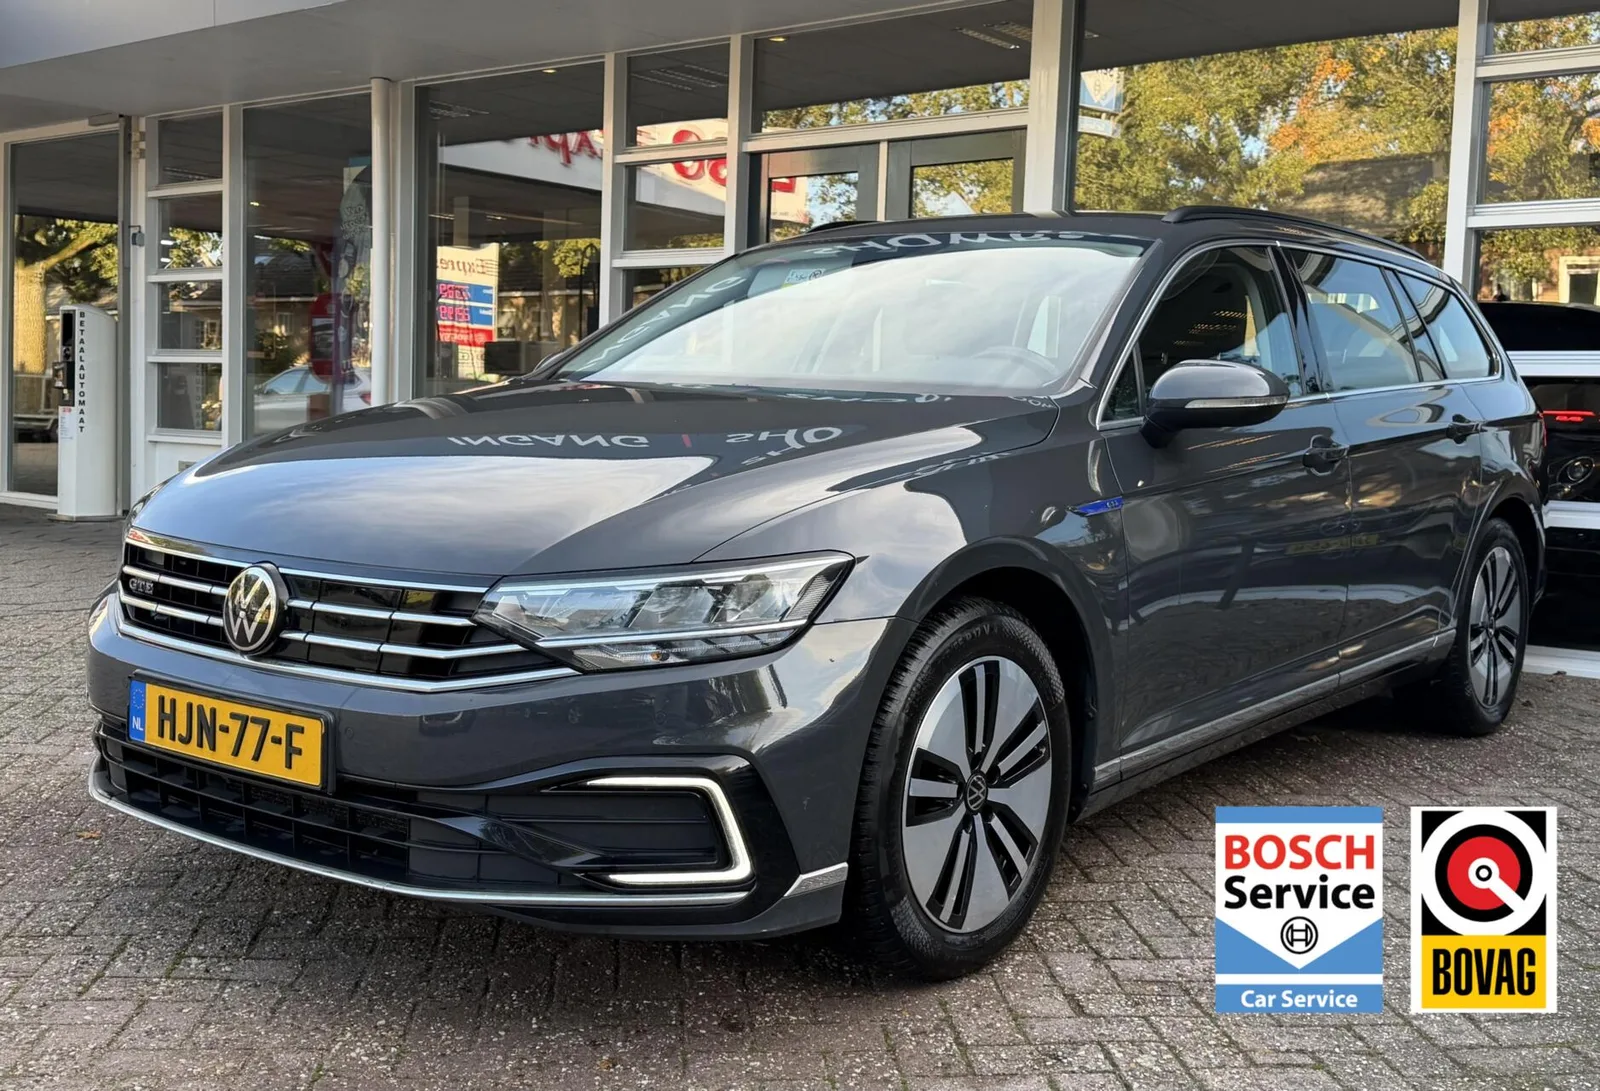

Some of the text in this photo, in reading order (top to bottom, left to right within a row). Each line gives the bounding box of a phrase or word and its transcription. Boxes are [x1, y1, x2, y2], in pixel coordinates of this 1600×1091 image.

[78, 311, 86, 433] BETAALAUTOMAAT
[128, 578, 155, 595] GTE
[131, 715, 144, 731] NL
[157, 694, 305, 770] HJN-77-F
